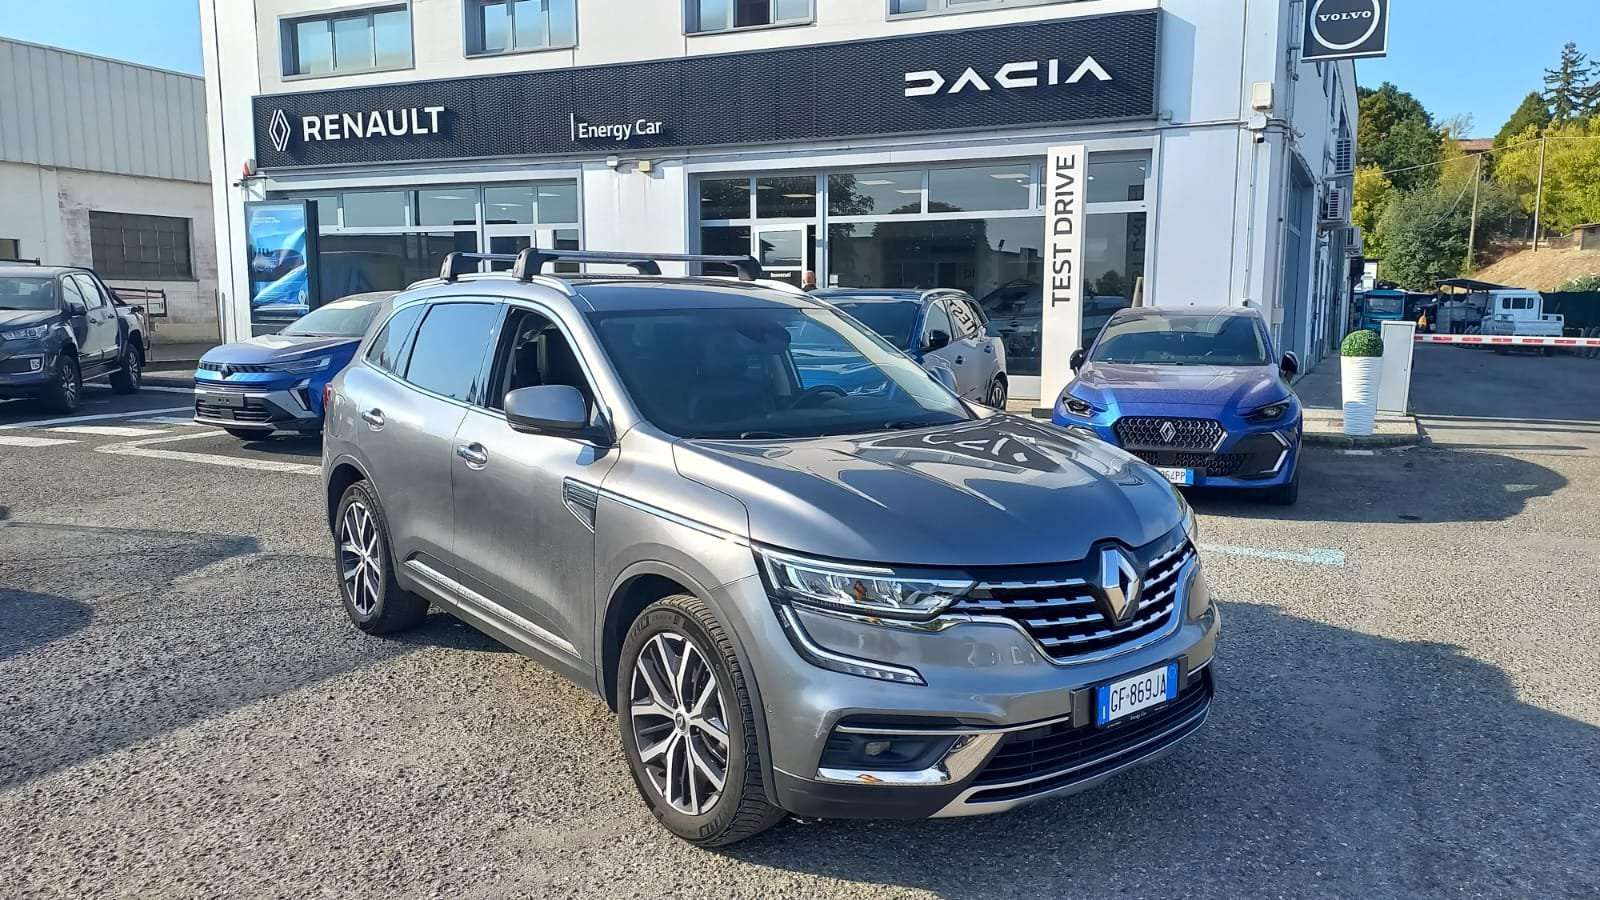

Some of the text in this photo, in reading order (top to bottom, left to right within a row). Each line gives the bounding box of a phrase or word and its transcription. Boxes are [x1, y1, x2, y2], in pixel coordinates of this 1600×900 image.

[1319, 10, 1372, 22] VOLVO
[904, 55, 1113, 97] DACIA
[302, 106, 445, 142] RENAULT
[578, 119, 663, 141] Energy Car
[1051, 154, 1075, 308] TEST DRIVE
